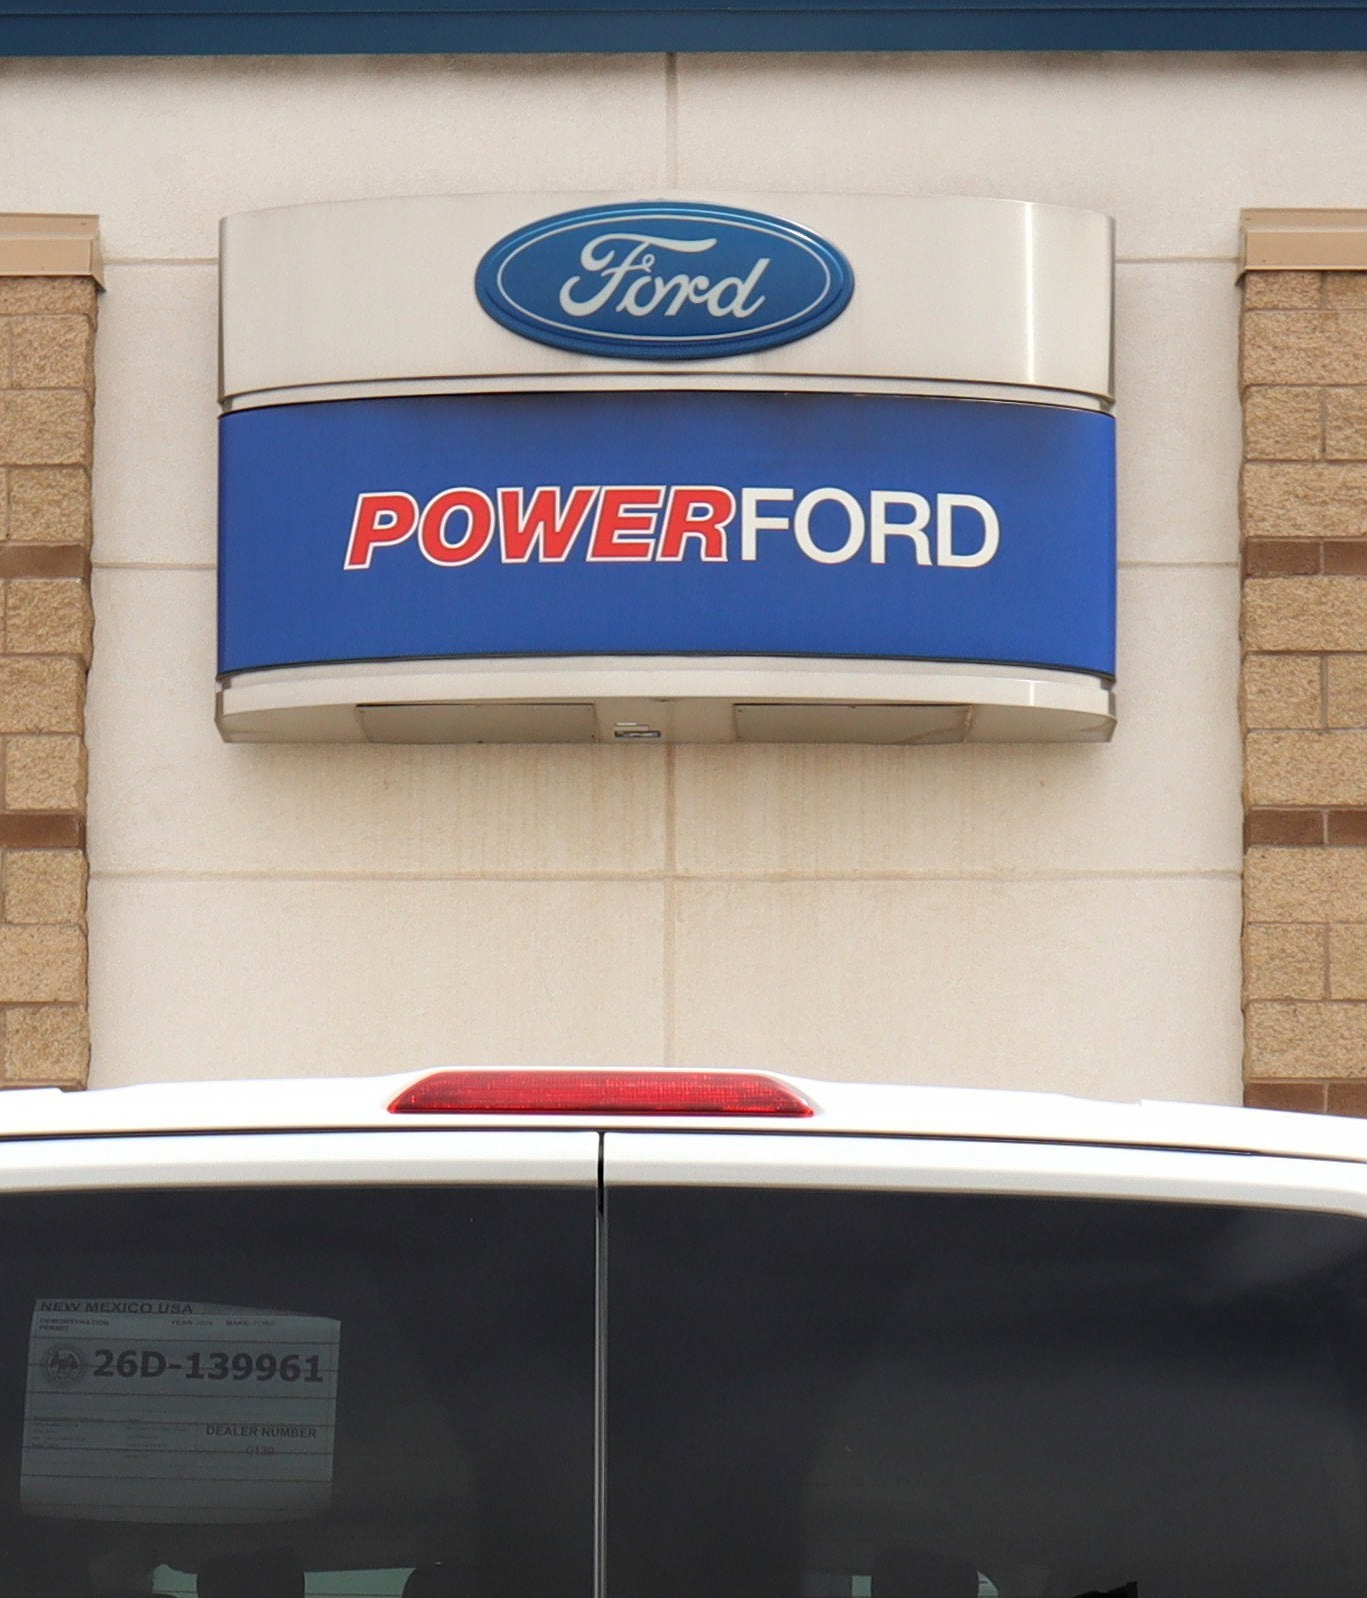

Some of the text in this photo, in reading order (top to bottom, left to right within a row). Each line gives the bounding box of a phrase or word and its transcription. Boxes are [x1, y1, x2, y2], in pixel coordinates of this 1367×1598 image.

[558, 232, 771, 320] Ford
[343, 484, 1001, 571] POWERFORD
[40, 1301, 193, 1314] NEW MEXICO USA
[92, 1349, 325, 1384] 26D-139961
[206, 1424, 317, 1440] DEALER NUMBER
